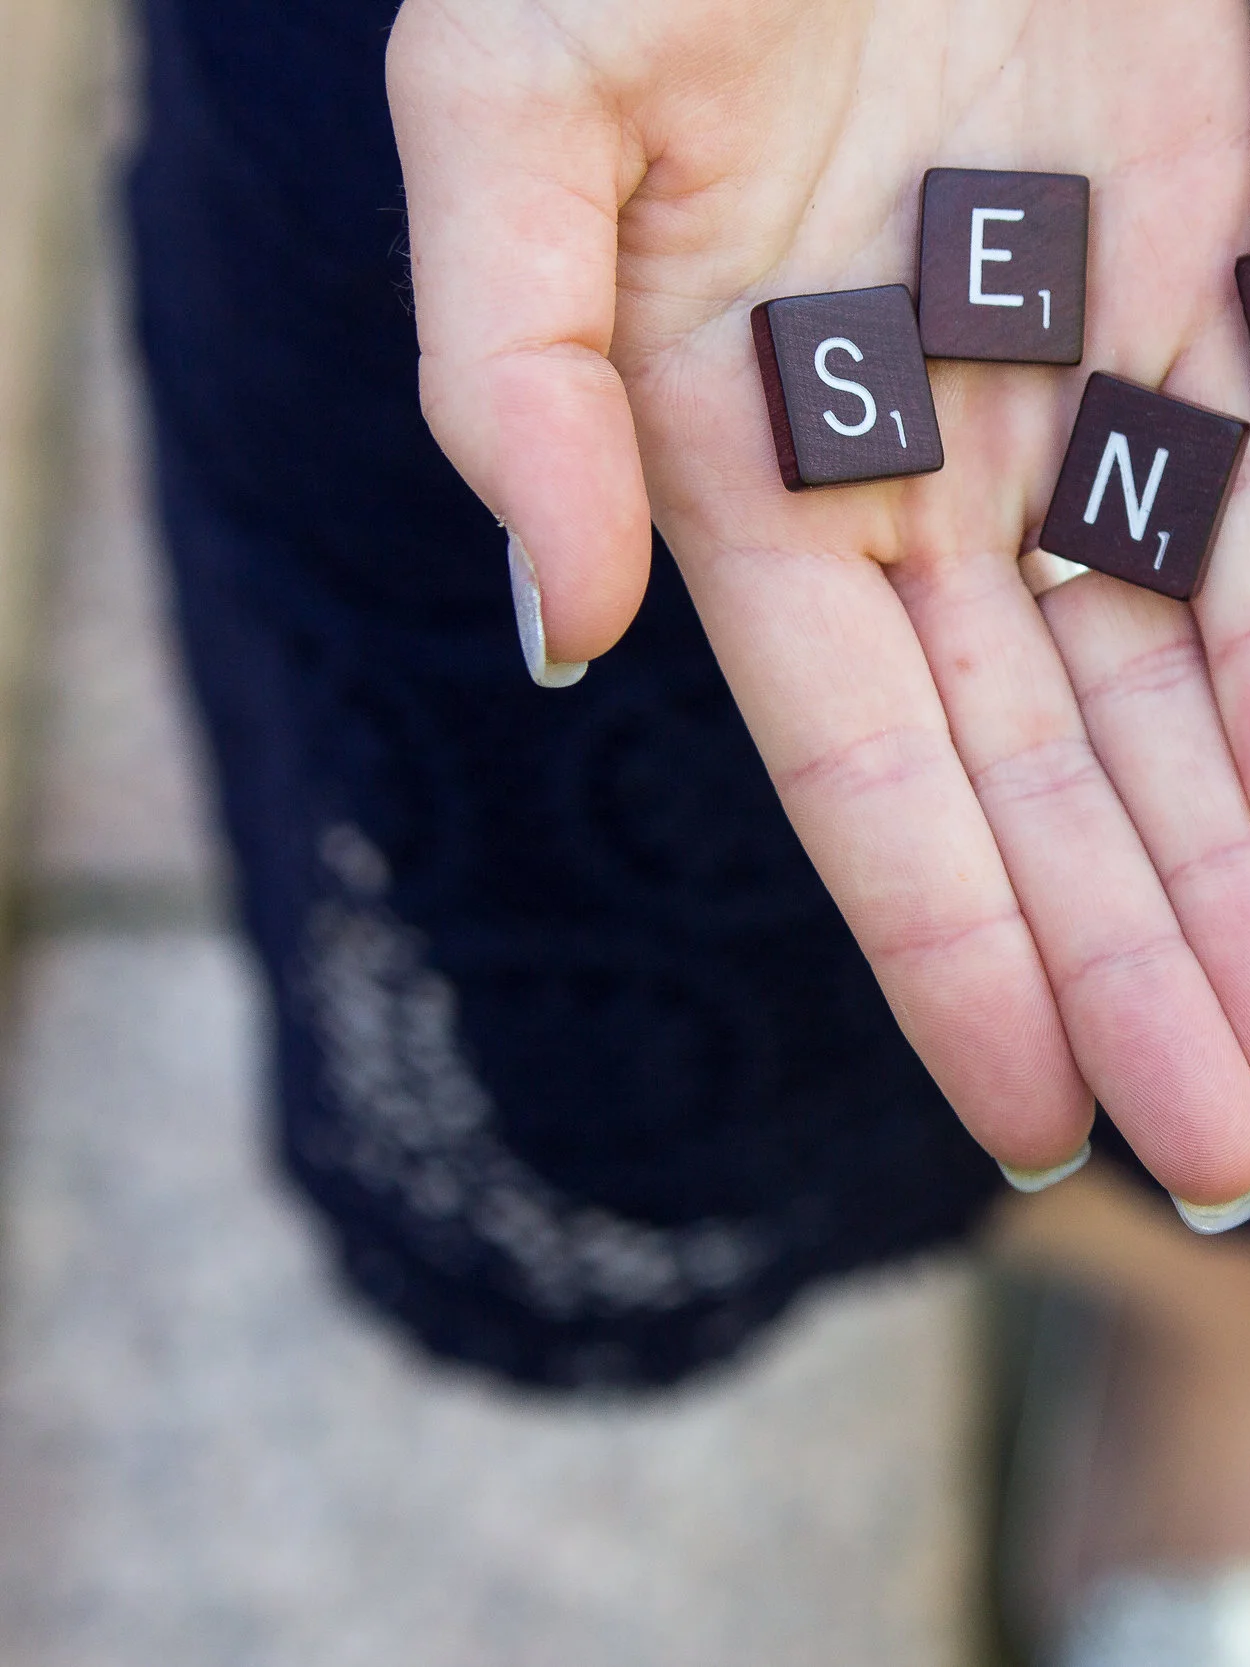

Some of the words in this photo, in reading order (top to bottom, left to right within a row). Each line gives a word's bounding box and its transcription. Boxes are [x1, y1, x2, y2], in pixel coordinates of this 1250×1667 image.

[968, 207, 1025, 307] E
[1037, 289, 1051, 330] 1
[813, 336, 878, 437] S
[889, 409, 908, 449] 1
[1083, 431, 1169, 542] N
[1153, 531, 1170, 570] 1
